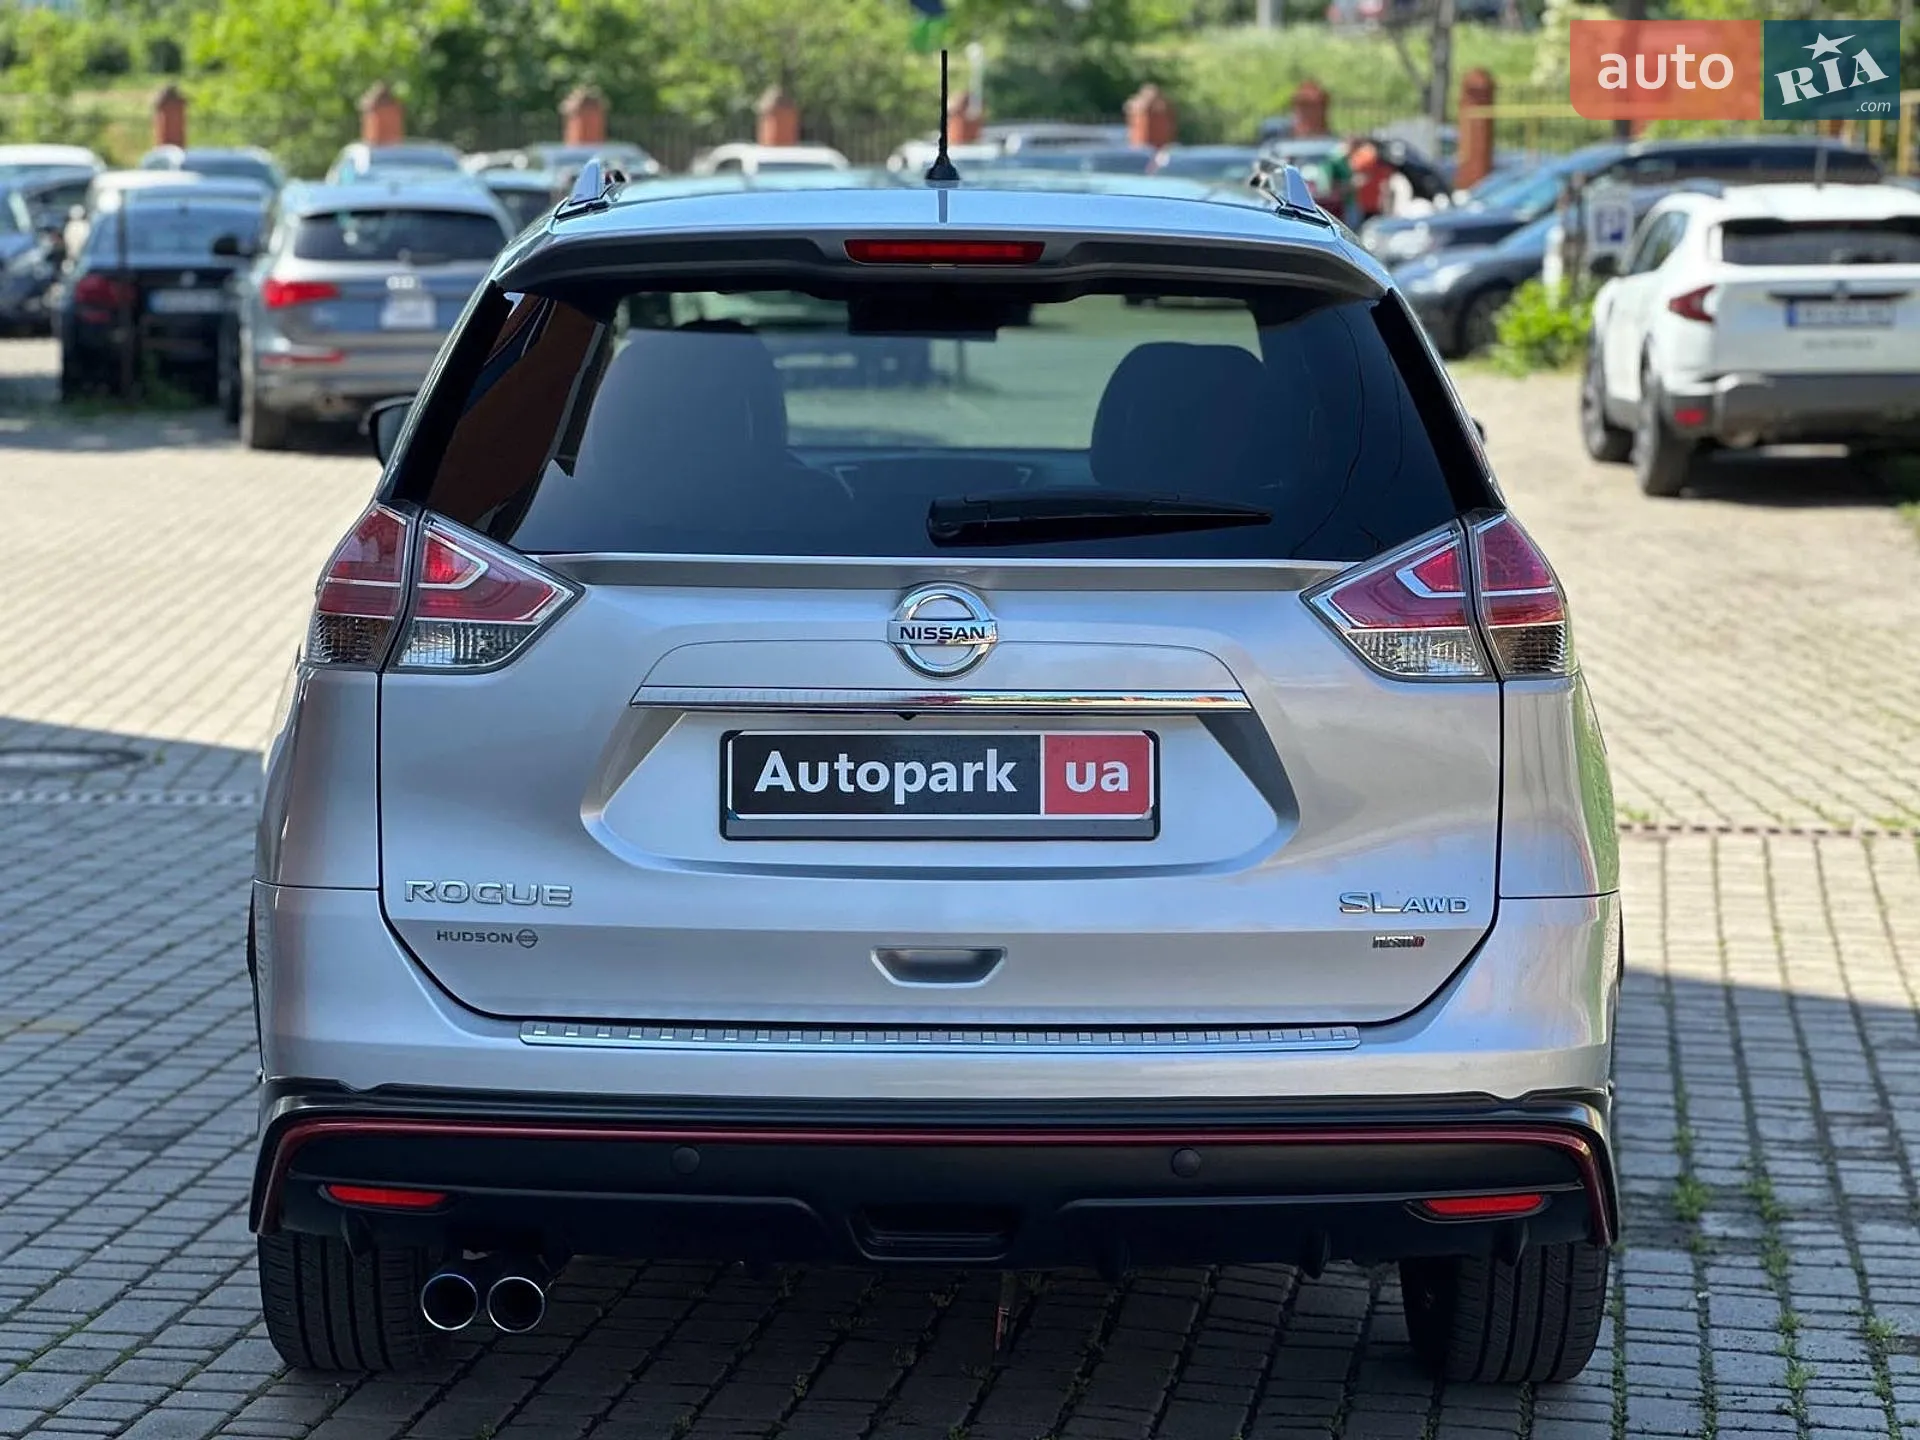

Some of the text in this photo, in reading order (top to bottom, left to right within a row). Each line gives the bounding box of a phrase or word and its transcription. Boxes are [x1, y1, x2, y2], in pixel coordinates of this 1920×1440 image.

[900, 626, 985, 640] NISSAN
[754, 748, 1129, 805] Autopark ua
[404, 879, 572, 907] ROGUE
[436, 929, 513, 944] HUDSON
